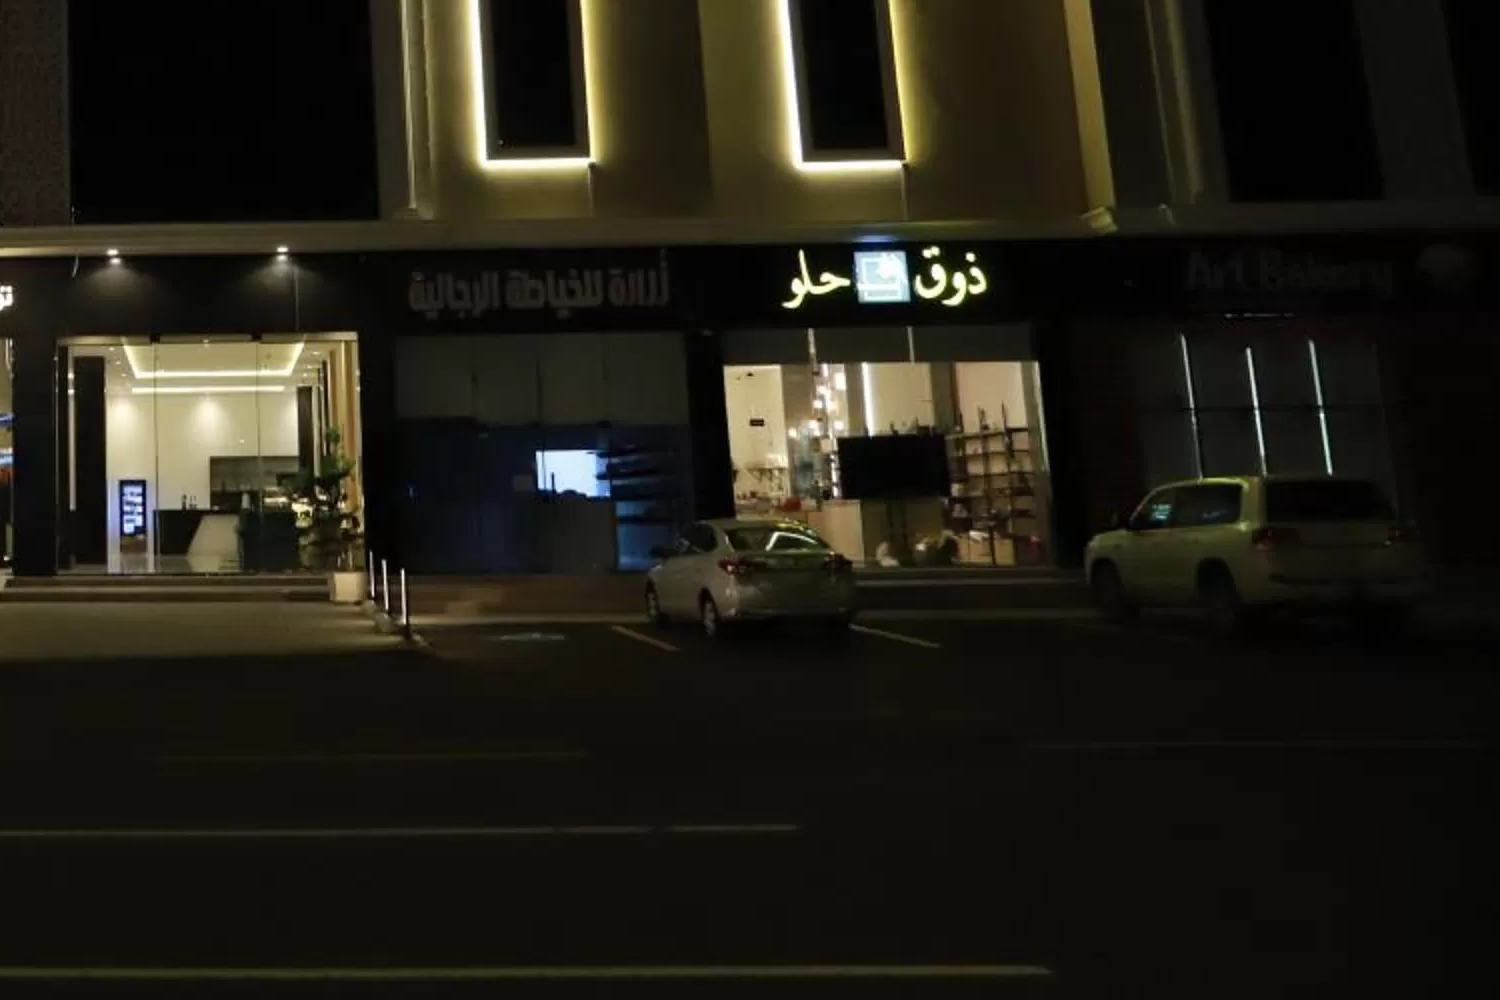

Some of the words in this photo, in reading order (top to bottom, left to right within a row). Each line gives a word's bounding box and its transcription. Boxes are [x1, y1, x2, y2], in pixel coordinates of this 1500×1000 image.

[781, 248, 851, 309] حلو
[914, 245, 988, 307] ذوق
[1185, 250, 1249, 291] Art
